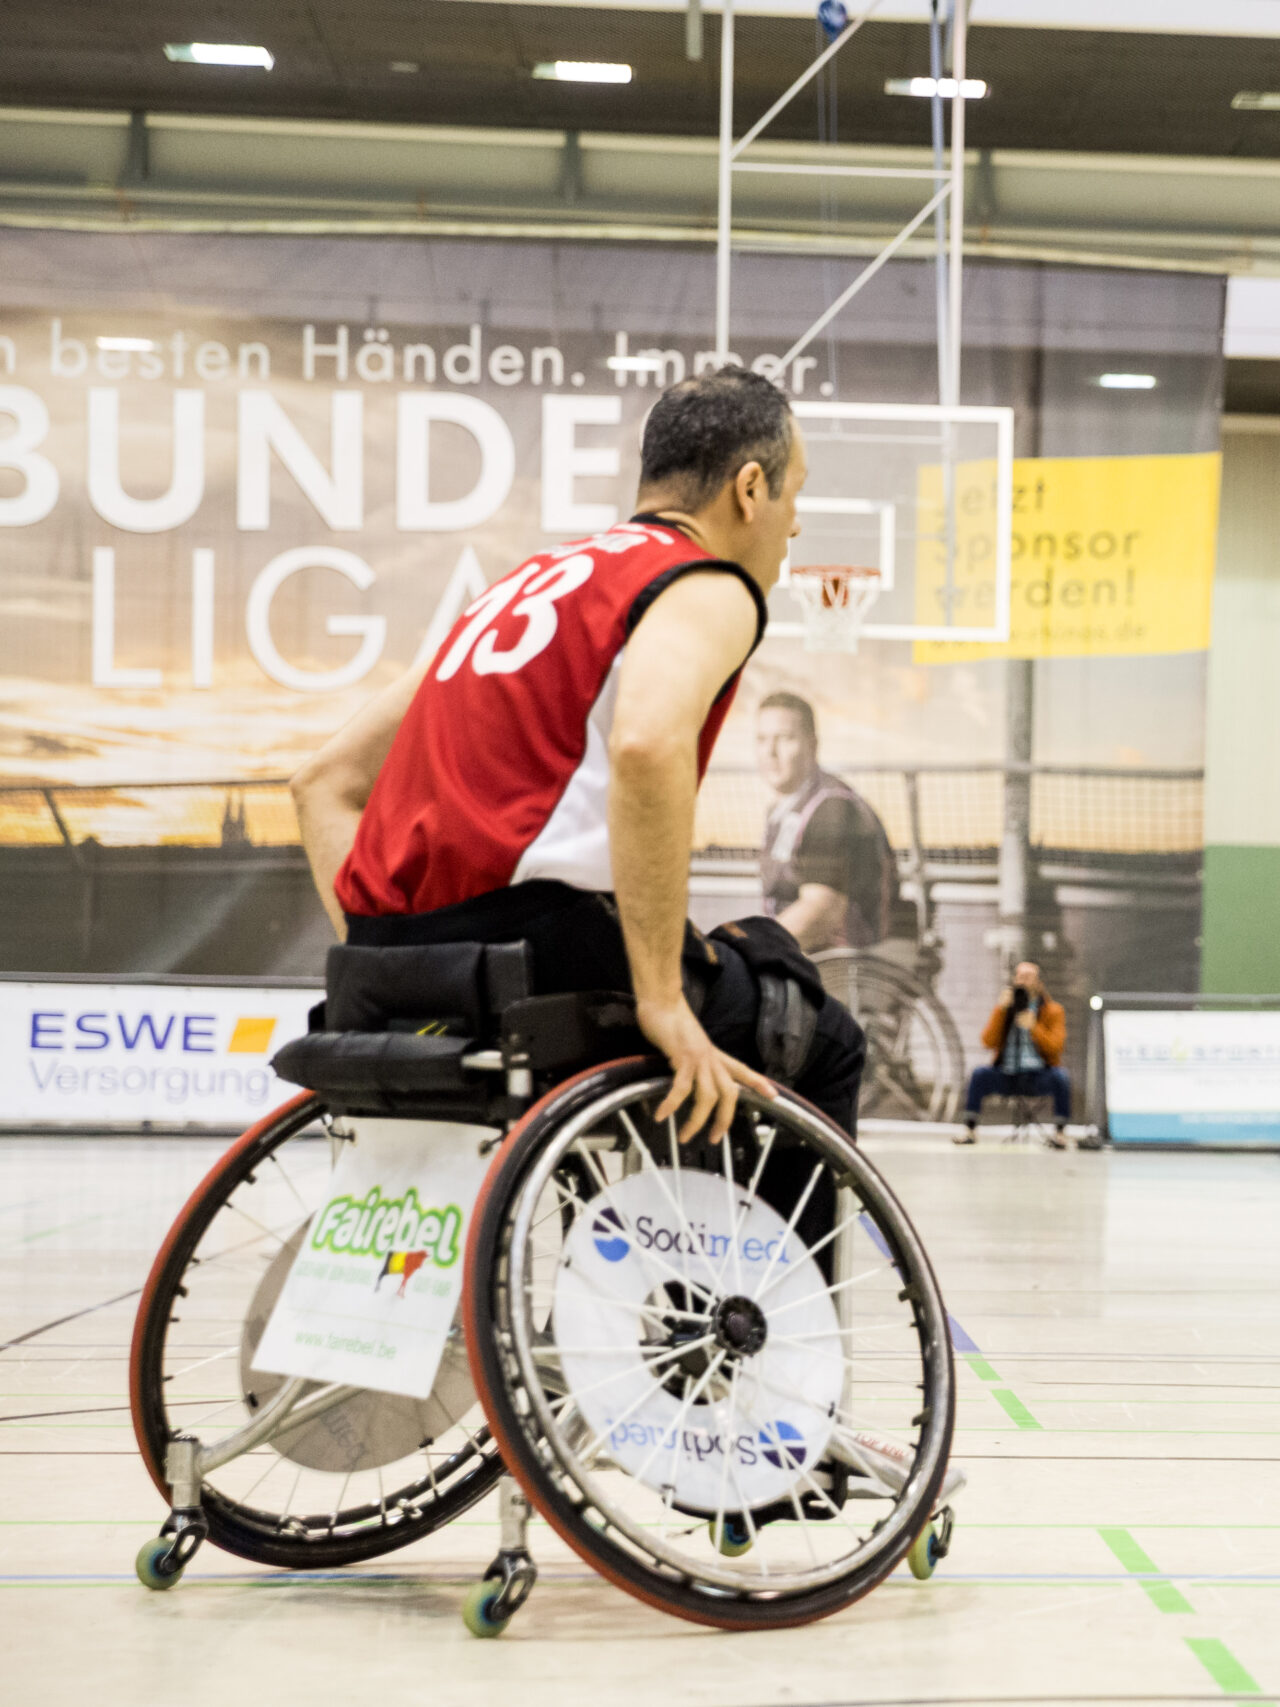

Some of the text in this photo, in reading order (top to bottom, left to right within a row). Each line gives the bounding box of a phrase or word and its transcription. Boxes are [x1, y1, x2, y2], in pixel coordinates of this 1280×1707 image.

[50, 319, 271, 382] besten
[302, 323, 586, 387] Händen.
[612, 330, 835, 397] Immer.
[435, 553, 595, 683] 13
[29, 1012, 217, 1053] ESWE
[28, 1057, 271, 1106] Versorgung
[312, 1186, 463, 1267] Fairebel
[635, 1215, 791, 1265] Sodimed
